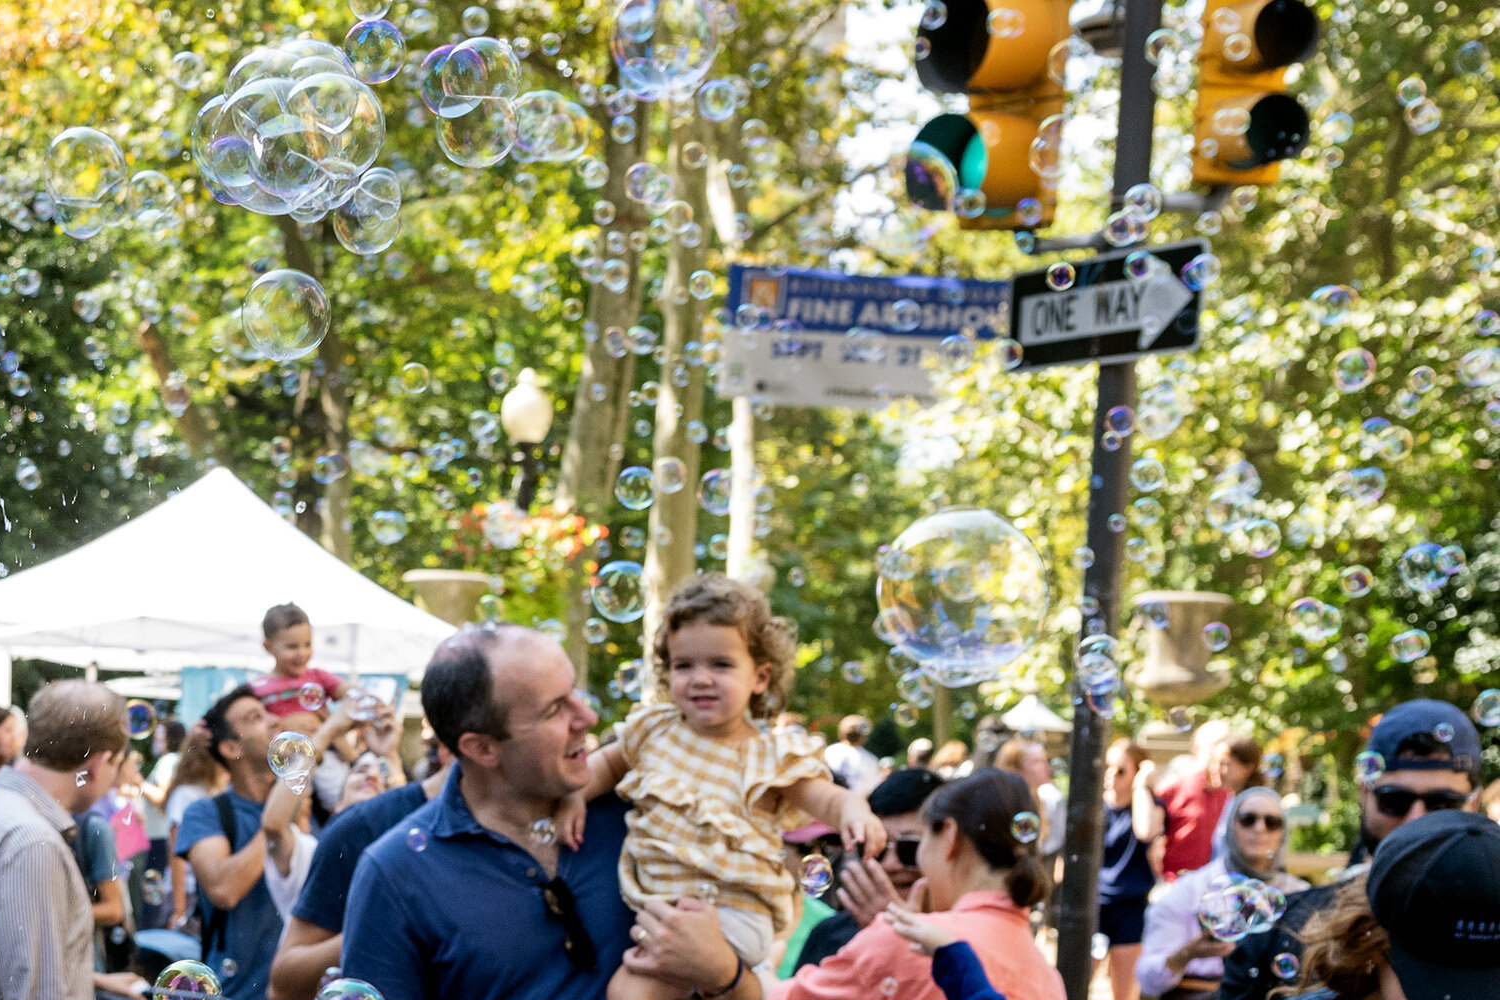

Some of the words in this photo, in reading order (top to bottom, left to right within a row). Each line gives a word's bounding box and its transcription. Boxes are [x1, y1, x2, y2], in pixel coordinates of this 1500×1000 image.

[786, 296, 854, 325] FINE
[1031, 294, 1077, 336] ONE
[1094, 282, 1148, 326] WAY
